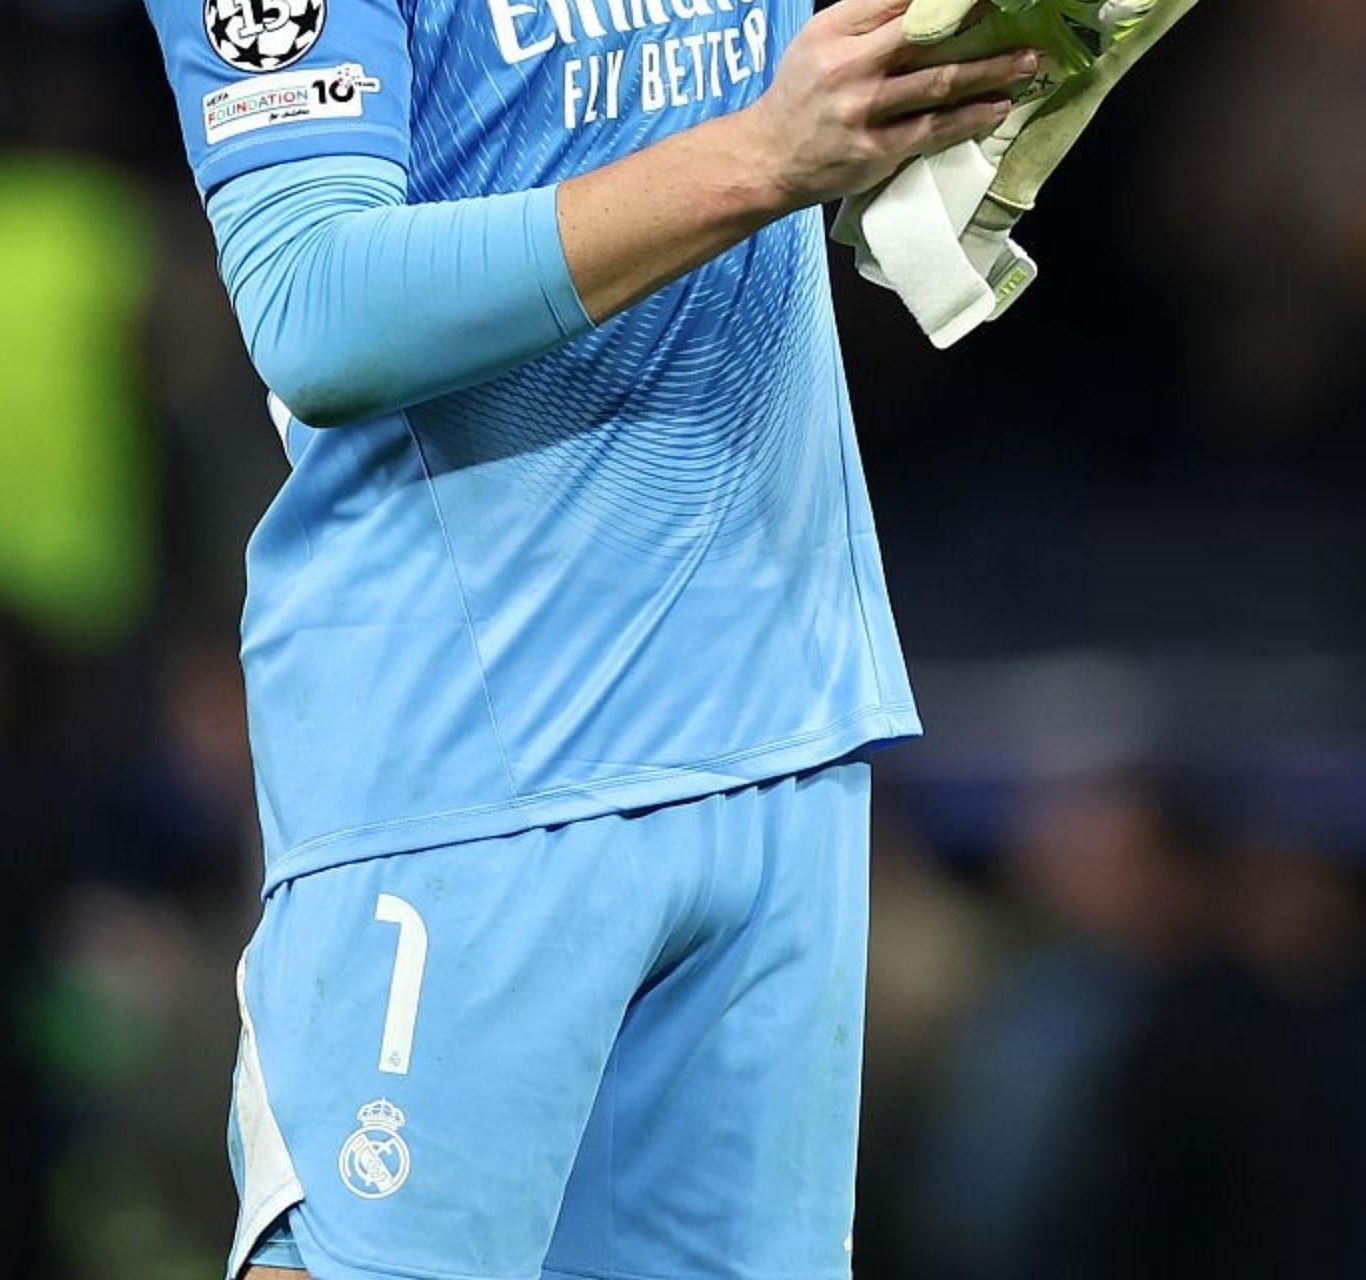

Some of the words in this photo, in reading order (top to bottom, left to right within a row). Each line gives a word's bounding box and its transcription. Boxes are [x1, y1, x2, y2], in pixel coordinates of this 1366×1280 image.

[311, 77, 355, 104] 10
[564, 50, 624, 129] FLY
[641, 8, 767, 112] BETTER
[375, 893, 427, 1075] 1
